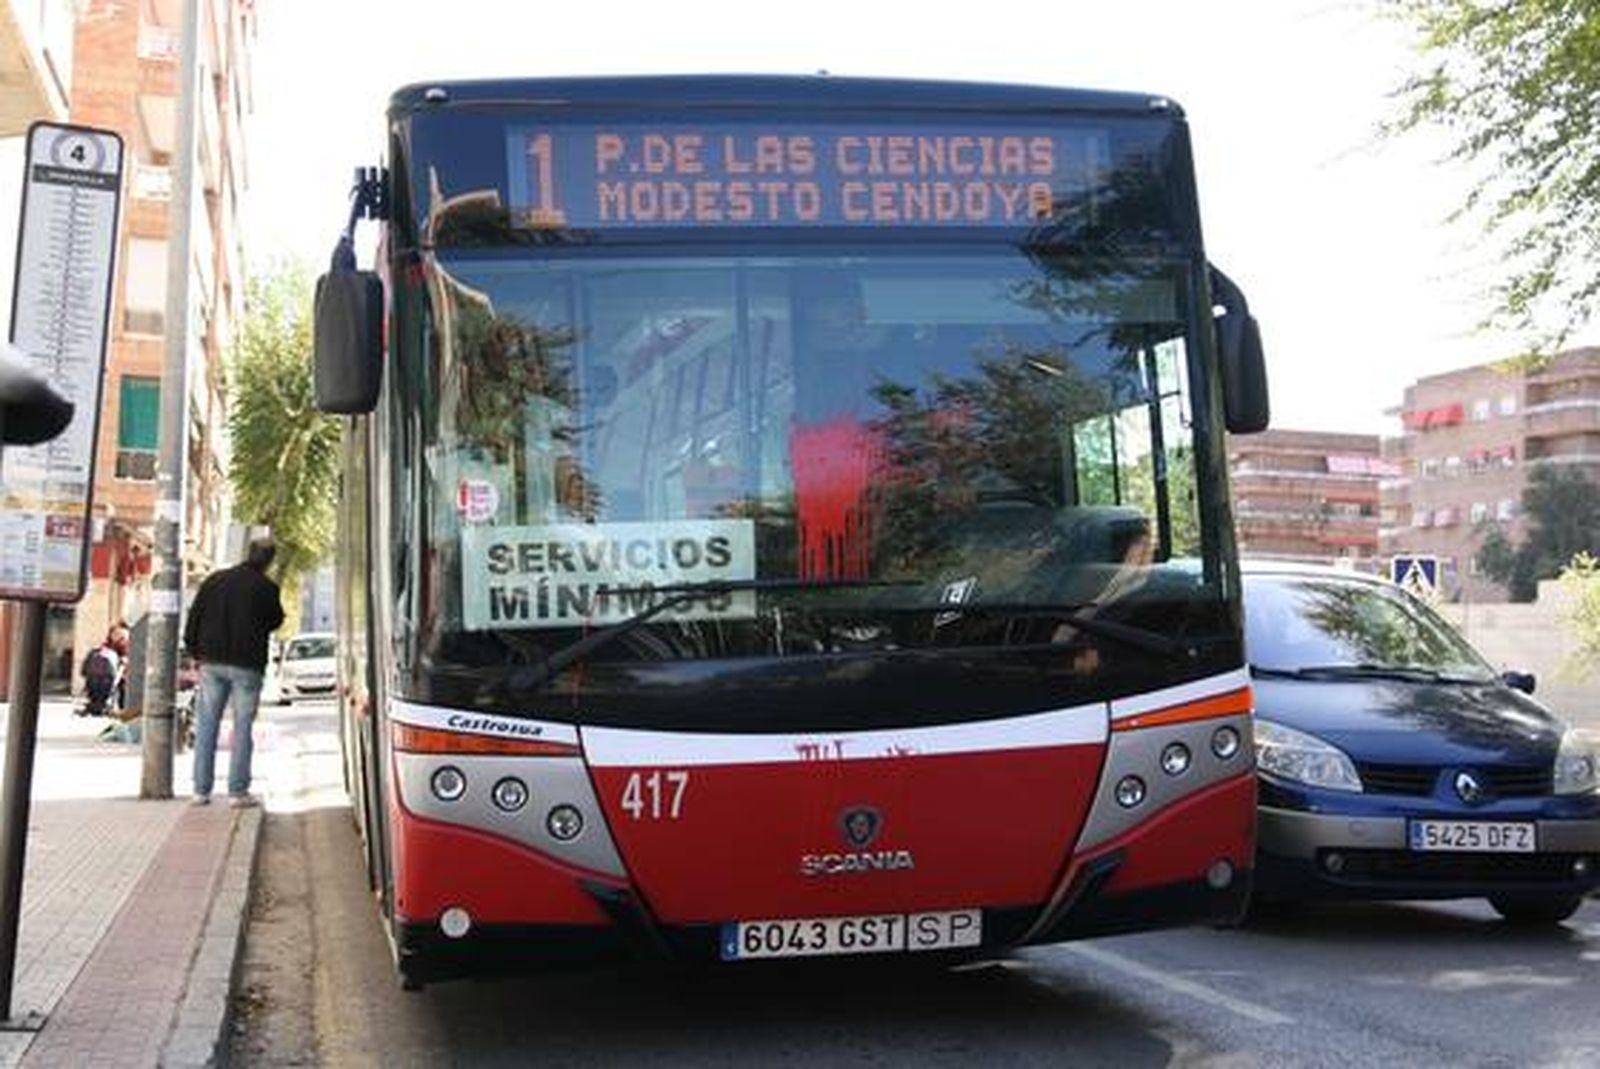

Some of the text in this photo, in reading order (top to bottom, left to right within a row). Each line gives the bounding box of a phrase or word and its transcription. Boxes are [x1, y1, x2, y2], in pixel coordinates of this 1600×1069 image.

[70, 145, 86, 162] 4
[527, 133, 1054, 229] 1 P.DE LAS CIENCIAS
[597, 182, 1053, 221] MODESTO CENDOYA
[488, 536, 732, 574] SERVICIOS
[448, 714, 543, 736] Castrosua
[621, 770, 688, 819] 417
[1426, 824, 1528, 848] 5425 DFZ
[801, 851, 914, 874] SCANIA
[744, 920, 827, 952] 6043
[838, 917, 898, 949] GST
